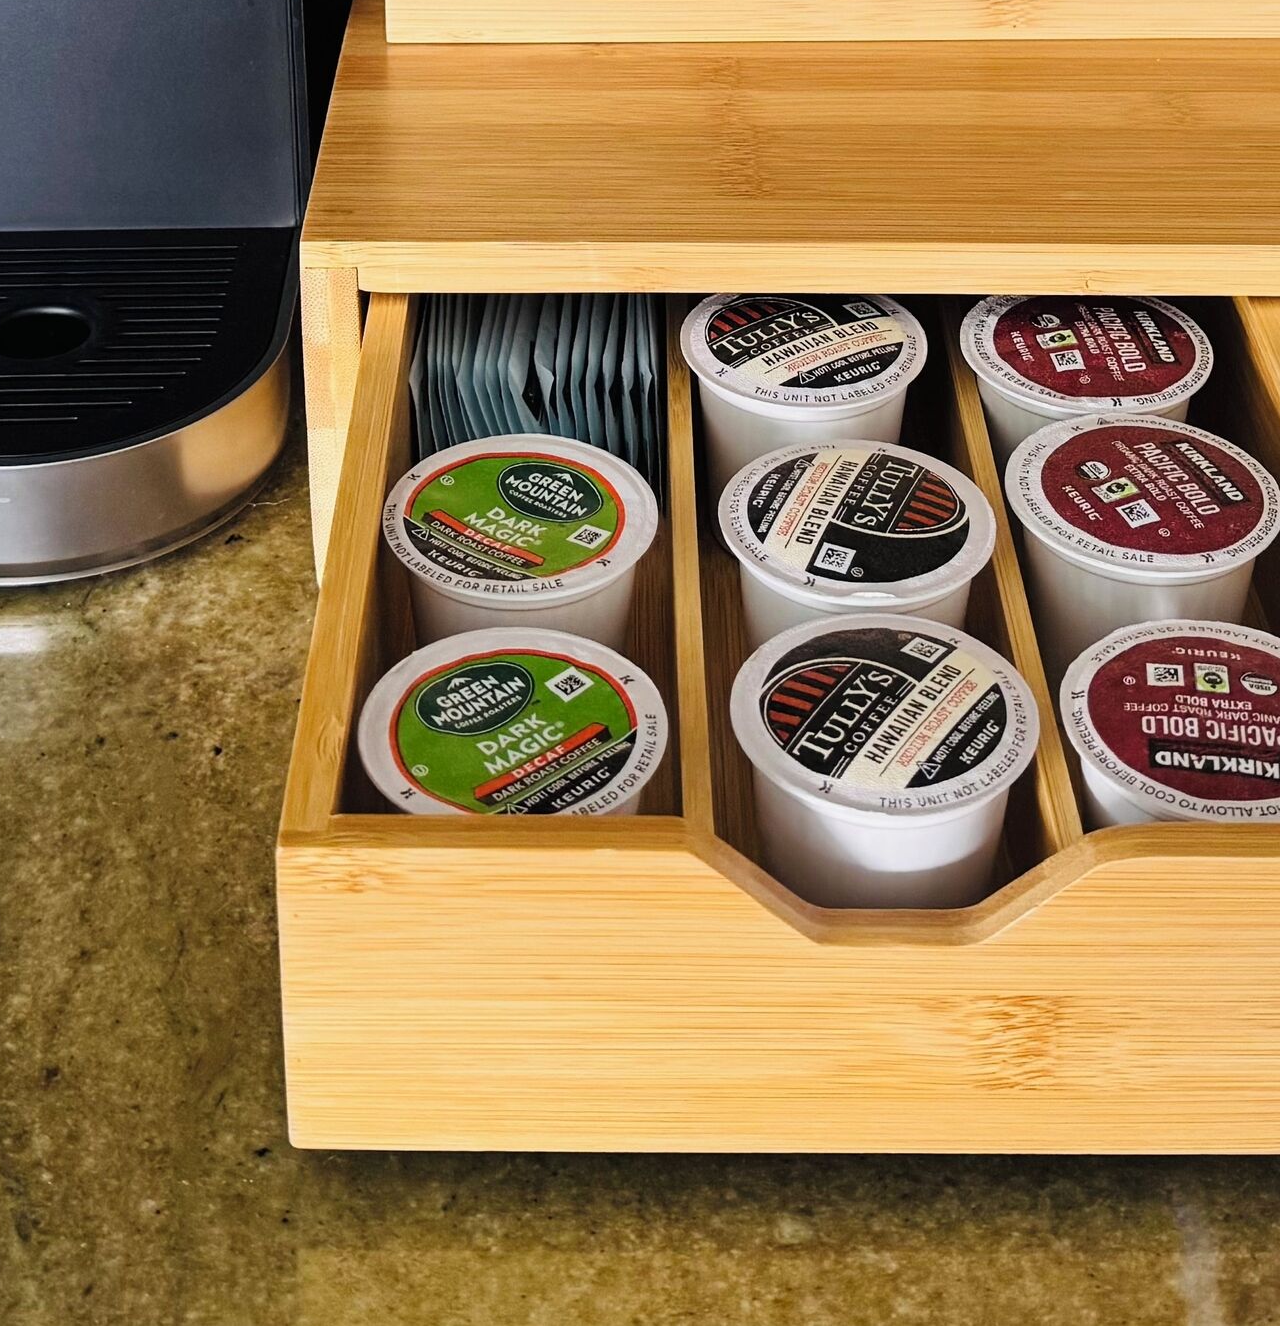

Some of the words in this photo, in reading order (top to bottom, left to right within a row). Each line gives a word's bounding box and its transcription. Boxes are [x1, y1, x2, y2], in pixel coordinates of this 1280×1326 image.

[712, 309, 820, 357] TULLY'S
[750, 326, 817, 357] COFFEE
[761, 333, 833, 366] HAWAIIAN
[836, 321, 879, 339] BLEND
[821, 342, 850, 358] ROAST
[1010, 330, 1034, 362] KEURIG
[1093, 306, 1130, 349] PACIFIC
[1116, 347, 1147, 373] BOLD
[1133, 310, 1176, 363] KIRKLAND
[754, 386, 779, 400] THIS
[783, 393, 810, 403] UNIT
[814, 393, 837, 403] NOT
[841, 382, 885, 401] LABELED
[886, 371, 902, 386] FOR
[899, 348, 917, 374] RETAIL
[833, 360, 881, 382] KEURIG
[529, 472, 584, 502] GREEN
[817, 460, 860, 506] HAWAIIAN
[848, 464, 877, 507] COFFEE
[1123, 464, 1150, 485] EXTRA
[1145, 482, 1168, 502] BOLD
[1133, 443, 1186, 483] PACIFIC
[1177, 479, 1222, 516] BOLD
[1175, 443, 1244, 501] KIRKLAND
[505, 474, 588, 517] MOUNTAIN
[752, 473, 781, 508] KEURIG
[853, 461, 918, 527] TULLY'S
[1061, 485, 1104, 521] KEURIG
[1157, 477, 1180, 500] ROAST
[1176, 500, 1205, 530] COFFEE
[385, 503, 396, 522] THIS
[486, 506, 547, 536] DARK
[796, 507, 831, 545] BLEND
[385, 523, 399, 543] UNIT
[393, 540, 410, 558] NOT
[430, 520, 457, 539] DARK
[456, 534, 489, 552] ROAST
[486, 548, 525, 566] COFFEE
[463, 527, 512, 552] DECAF
[1052, 525, 1074, 542] FOR
[1075, 538, 1117, 559] RETAIL
[1122, 552, 1155, 563] SALE
[407, 555, 452, 585] LABELED
[427, 549, 484, 578] KEURIG
[744, 542, 769, 563] SALE
[454, 579, 480, 591] FOR
[484, 583, 527, 594] RETAIL
[533, 578, 564, 592] SALE
[1175, 646, 1241, 660] KEURIG
[430, 677, 527, 726] MOUNTAIN
[436, 675, 501, 709] GREEN
[484, 695, 523, 718] ROASTERS
[1123, 702, 1169, 713] COFFEE
[1175, 694, 1208, 705] BOLD
[1210, 698, 1253, 711] EXTRA
[792, 670, 893, 761] TULLY'S
[843, 694, 898, 754] COFFEE
[864, 698, 928, 764] HAWAIIAN
[925, 663, 962, 702] BLEND
[895, 733, 929, 767] MEDIUM
[925, 706, 954, 737] ROAST
[947, 679, 978, 708] COFFEE
[947, 726, 965, 748] COOL
[978, 691, 1000, 715] PEELING
[1141, 716, 1199, 737] BOLD
[1172, 705, 1213, 719] ROAST
[1215, 709, 1249, 722] DARK
[476, 713, 546, 756] DARK
[958, 720, 1000, 764] KEURIG
[491, 779, 525, 802] DARK
[521, 762, 561, 785] ROAST
[559, 737, 602, 767] COFFEE
[512, 744, 566, 779] DECAF
[620, 772, 641, 795] FOR
[637, 741, 657, 774] RETAIL
[649, 713, 657, 740] SALE
[880, 796, 912, 809] THIS
[917, 792, 951, 808] UNIT
[954, 782, 978, 799] NOT
[980, 752, 1020, 788] LABELED
[1016, 729, 1028, 749] FOR
[1100, 754, 1139, 787] BEFORE
[1154, 749, 1280, 781] KIRKLAND
[546, 778, 570, 795] COOL
[568, 760, 599, 785] BEFORE
[552, 767, 610, 810] KEURIG
[1137, 780, 1176, 804] COOL
[1179, 799, 1203, 812] TO
[1205, 803, 1253, 817] ALLOW
